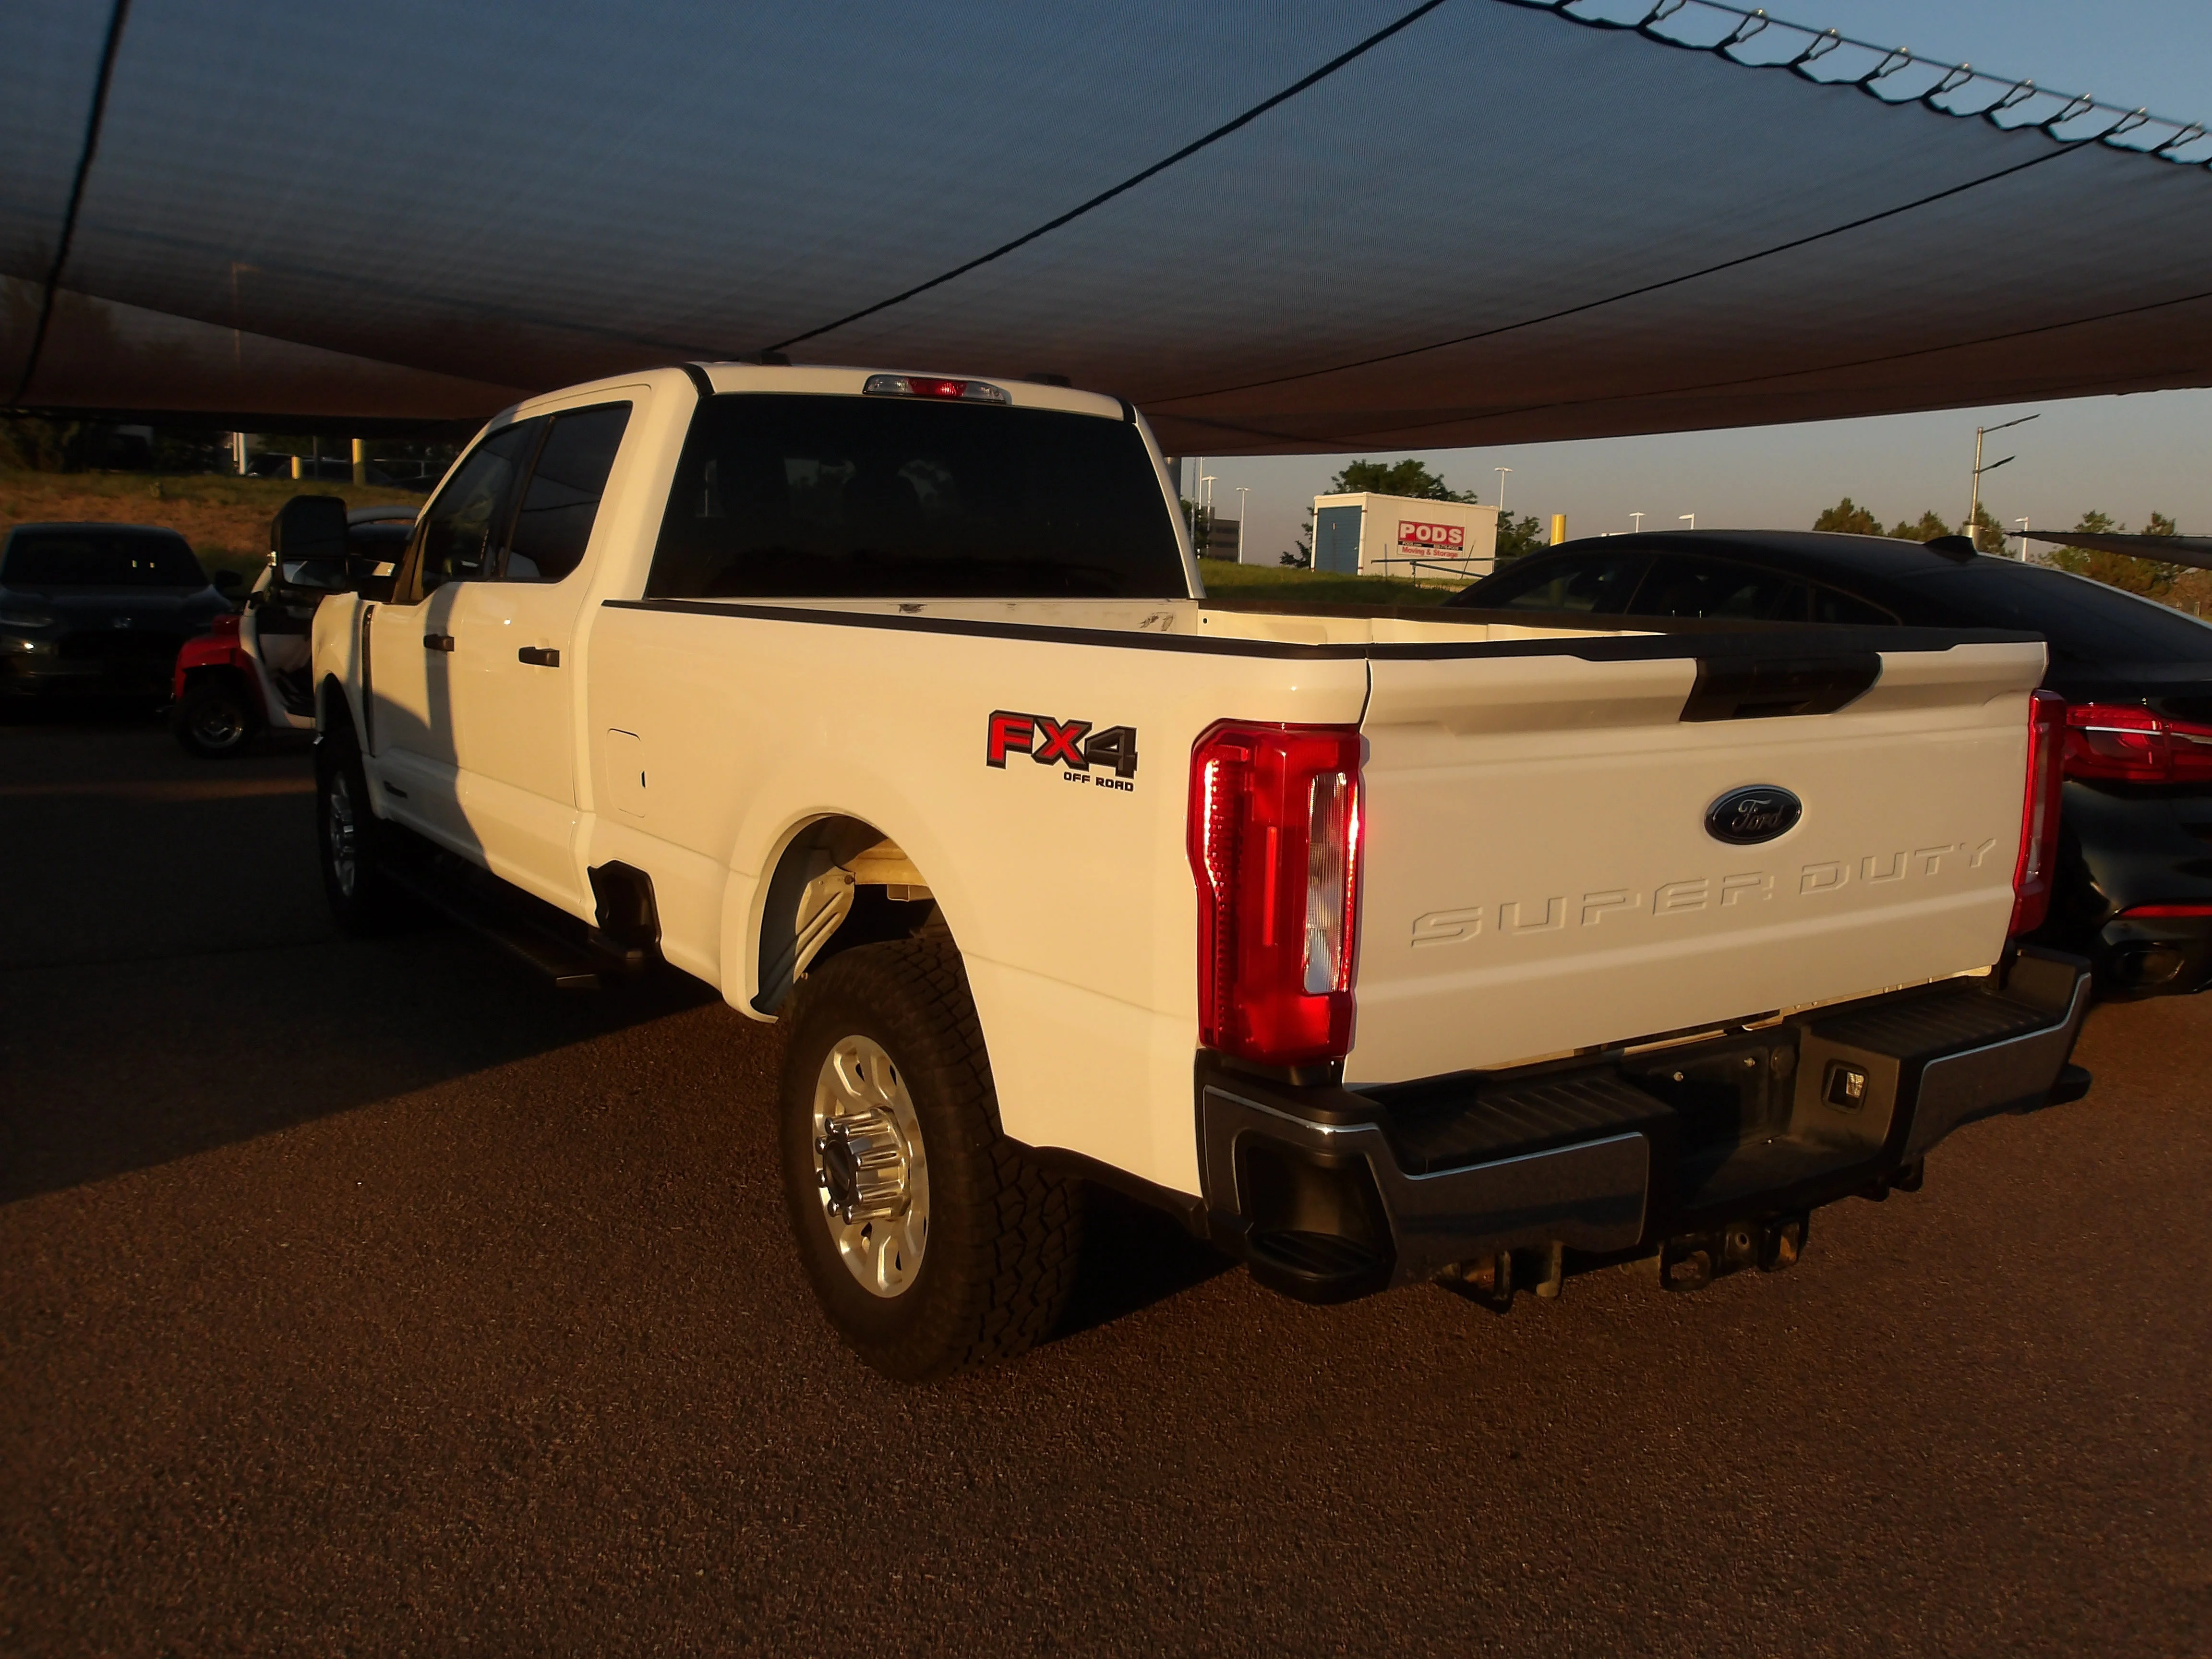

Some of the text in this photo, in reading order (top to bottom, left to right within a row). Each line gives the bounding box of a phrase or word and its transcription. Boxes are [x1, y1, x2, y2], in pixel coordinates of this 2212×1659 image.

[1400, 523, 1462, 543] PODS
[1402, 546, 1425, 556] Moving
[1433, 549, 1458, 559] Storage
[986, 709, 1138, 780] FX4
[1063, 771, 1134, 792] OFF ROAD
[1731, 799, 1783, 833] Ford
[1411, 838, 1997, 948] SUPER DUTY
